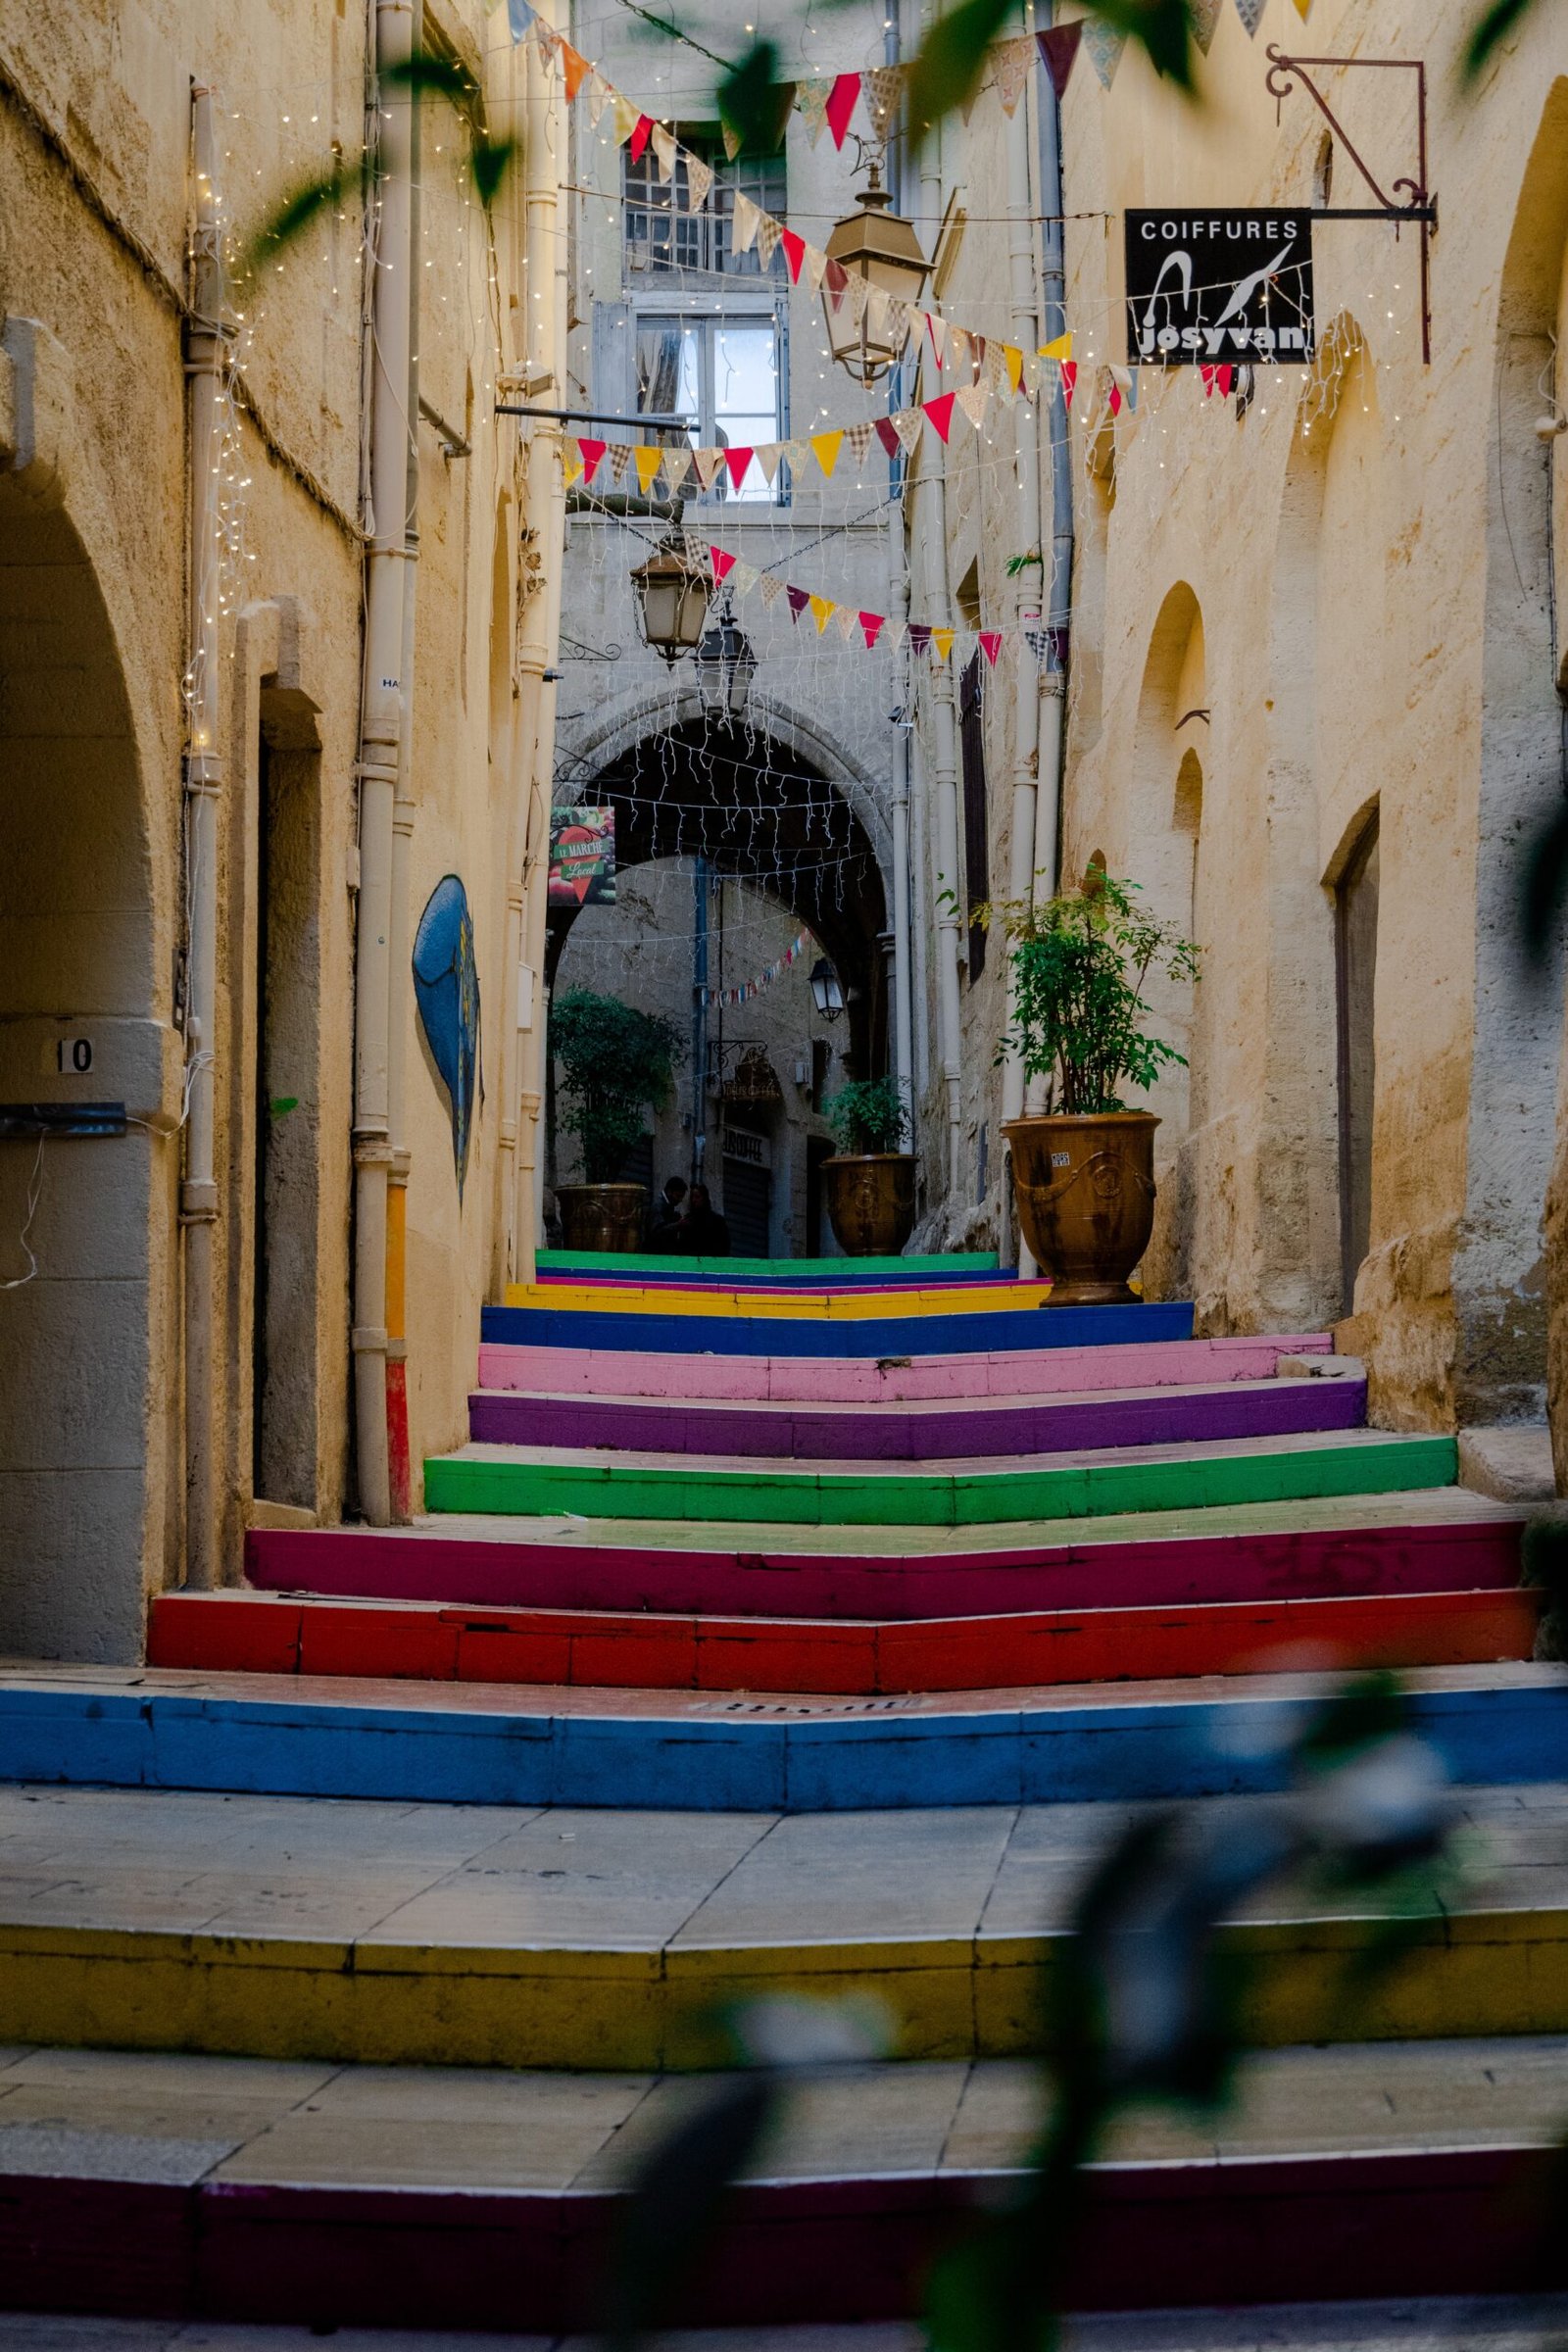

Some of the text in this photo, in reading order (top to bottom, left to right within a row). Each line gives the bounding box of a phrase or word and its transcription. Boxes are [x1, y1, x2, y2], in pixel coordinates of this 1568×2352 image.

[1141, 220, 1298, 240] COIFFURES
[1139, 324, 1305, 355] josyvan
[566, 861, 597, 880] Local
[57, 1038, 92, 1072] 10
